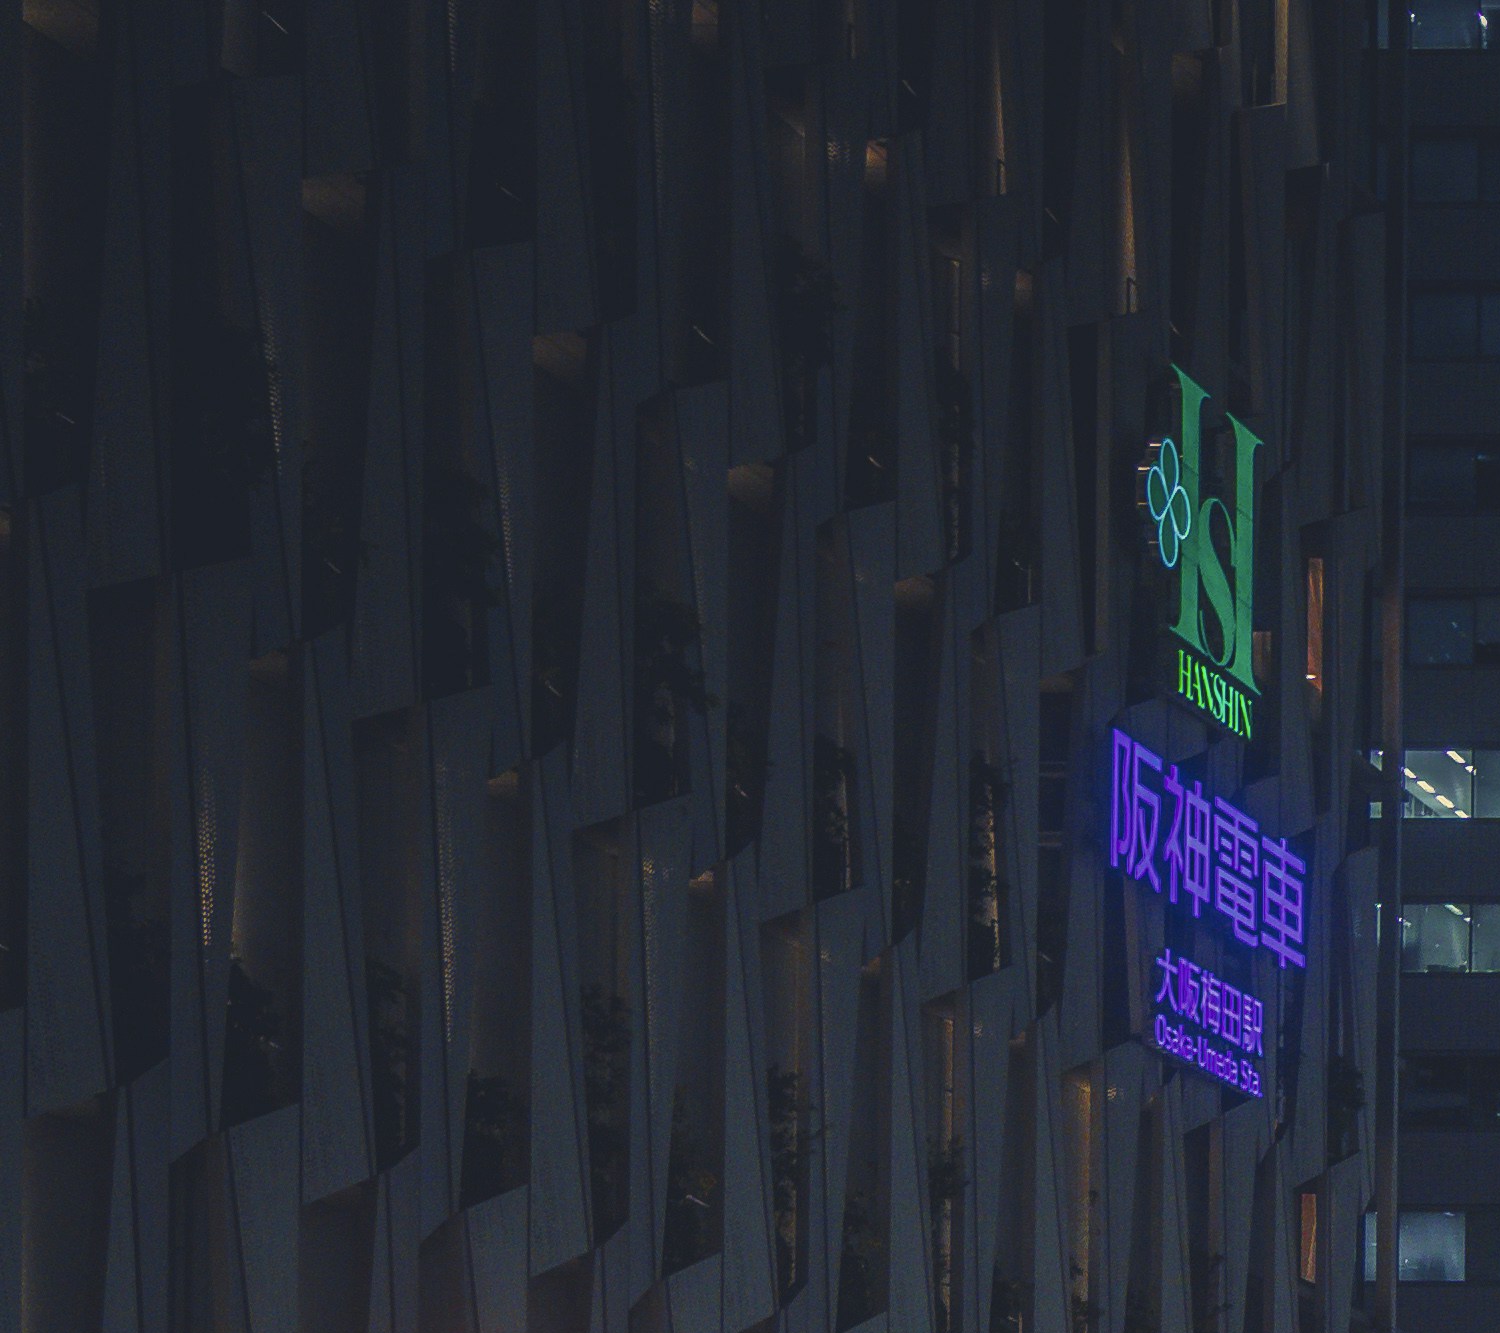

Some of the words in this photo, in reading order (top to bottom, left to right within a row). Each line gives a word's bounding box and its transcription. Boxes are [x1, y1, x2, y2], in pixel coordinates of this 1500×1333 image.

[1177, 649, 1252, 741] HANSHIN
[1110, 727, 1307, 968] 阪神電車
[1155, 947, 1264, 1058] 大阪梅田駅
[1155, 1012, 1238, 1085] Osaka-Umeda
[1240, 1060, 1263, 1099] Sta.
